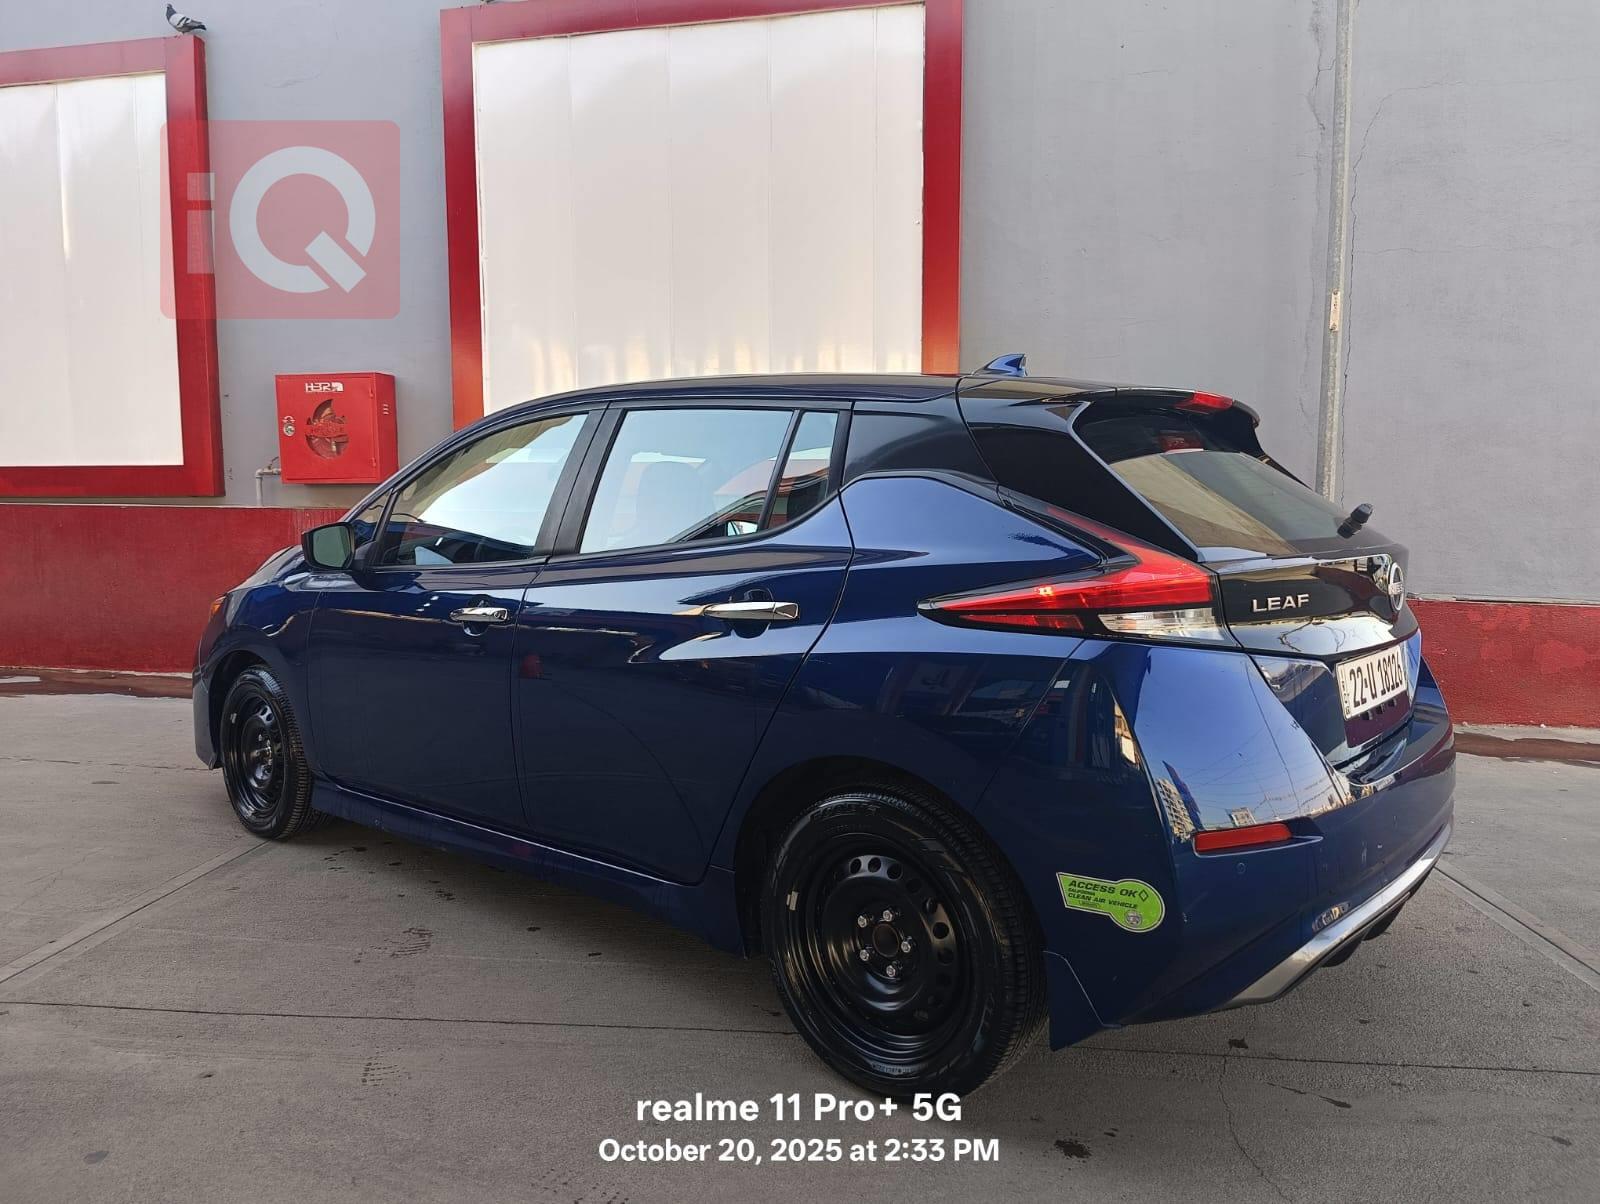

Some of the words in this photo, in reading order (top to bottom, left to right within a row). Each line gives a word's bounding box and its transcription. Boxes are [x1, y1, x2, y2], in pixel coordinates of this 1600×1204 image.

[1252, 593, 1310, 613] LEAF
[1377, 651, 1403, 697] 18126
[1068, 880, 1116, 894] ACCESS
[1120, 888, 1139, 898] OK
[1068, 892, 1092, 901] CLEAN
[1108, 900, 1138, 910] VEHICLE
